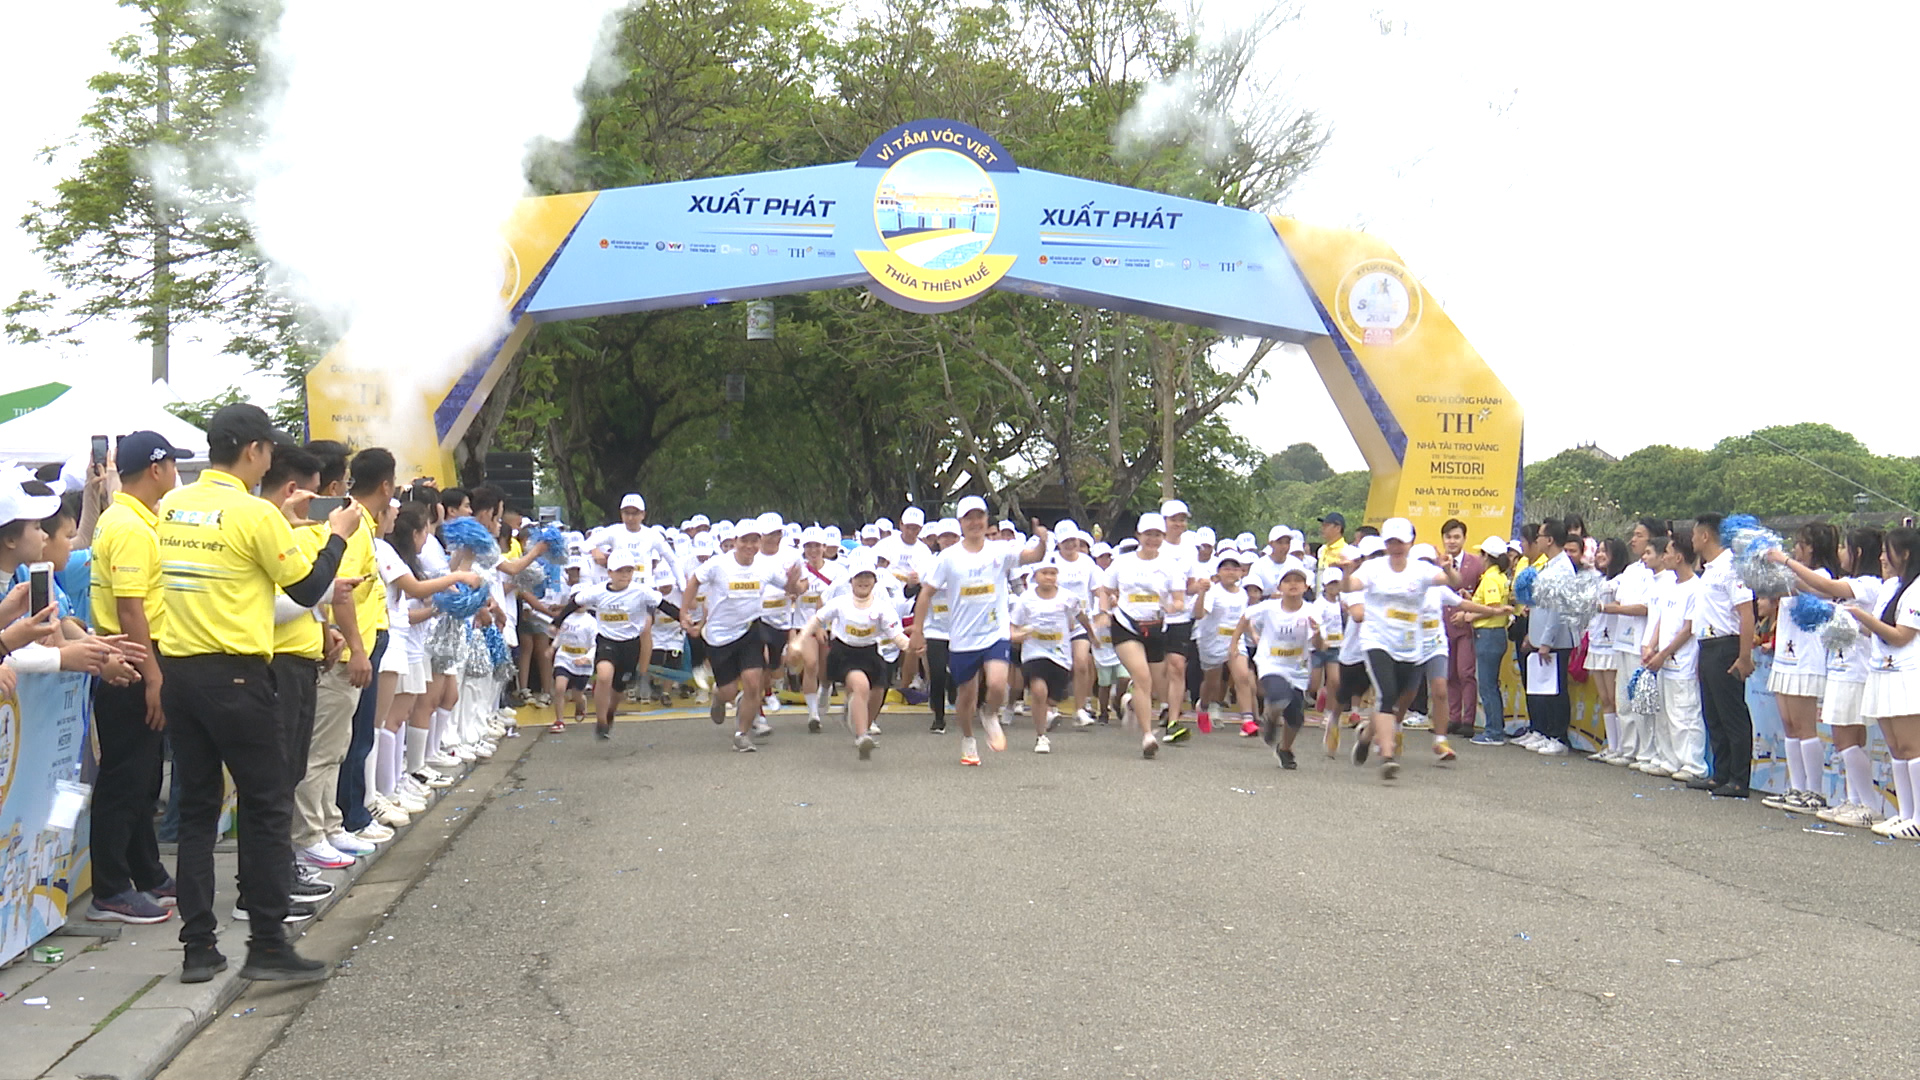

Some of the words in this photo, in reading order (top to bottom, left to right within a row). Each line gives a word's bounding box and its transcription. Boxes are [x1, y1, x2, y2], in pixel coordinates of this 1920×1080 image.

[876, 143, 895, 161] VÌ
[892, 129, 929, 151] TẦM
[931, 128, 964, 146] VÓC
[966, 137, 998, 164] VIỆT
[687, 187, 761, 215] XUẤT
[763, 194, 836, 218] PHÁT
[1040, 201, 1110, 227] XUẤT
[1113, 207, 1183, 230] PHÁT
[885, 264, 917, 289] THỪA
[922, 279, 962, 292] THIÊN
[964, 262, 990, 286] HUẾ
[1476, 396, 1502, 405] HÀNH
[1437, 412, 1475, 433] TH
[1417, 441, 1436, 450] NHÀ
[1439, 442, 1452, 450] TÀI
[1454, 443, 1473, 452] TRỢ
[1474, 442, 1499, 452] VÀNG
[1430, 461, 1485, 475] MISTORI
[1415, 486, 1434, 495] NHÀ
[1437, 487, 1450, 496] TÀI
[1452, 488, 1471, 497] TRỢ
[1472, 487, 1499, 497] ĐỒNG
